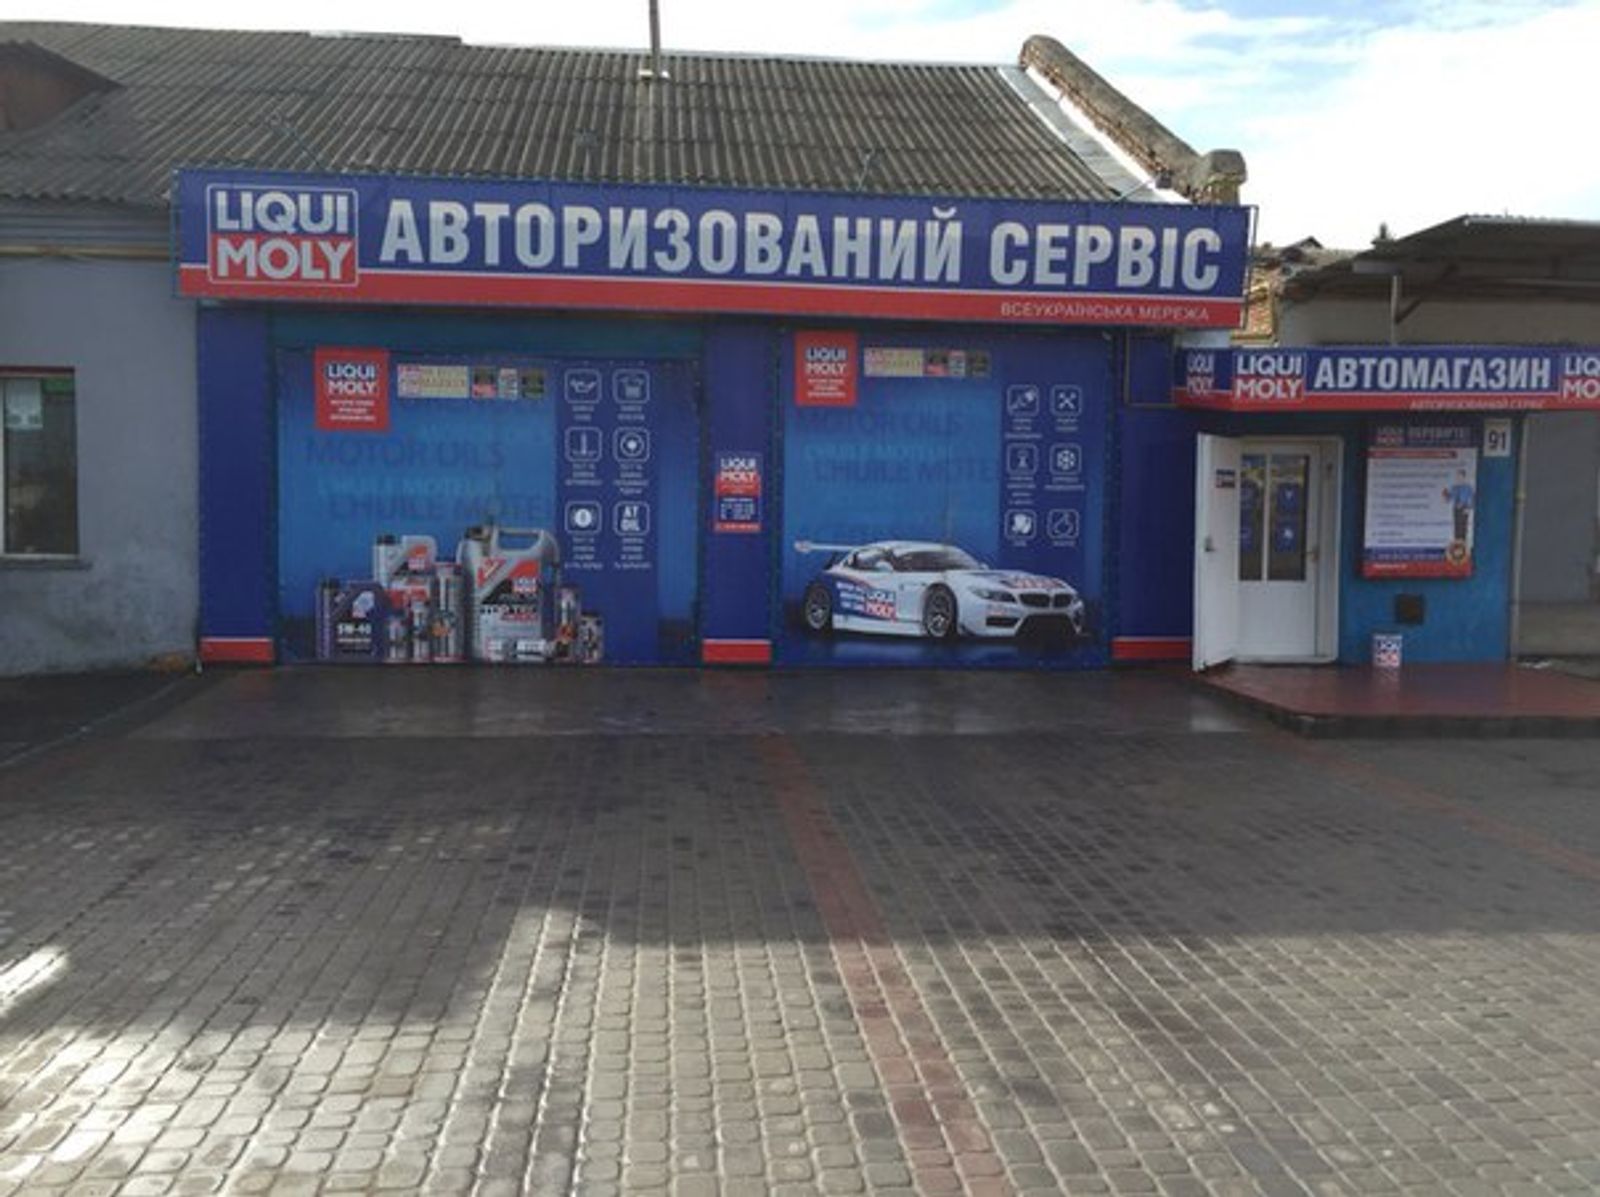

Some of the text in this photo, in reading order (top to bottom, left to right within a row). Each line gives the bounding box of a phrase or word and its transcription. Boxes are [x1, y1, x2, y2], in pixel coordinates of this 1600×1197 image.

[214, 190, 348, 234] LIQUI
[380, 198, 1222, 291] АВТОРИЗОВАНИЙ СЕРВІС
[215, 237, 353, 281] MOLY
[1000, 302, 1210, 321] ВСЕУКРАЇНСЬКА МЕРЕЖА
[806, 347, 847, 362] LIQUI
[1187, 353, 1215, 373] LIQUI
[327, 363, 376, 379] LIQUI
[805, 362, 847, 375] MOLY
[1236, 354, 1302, 377] LIQUI
[1313, 357, 1551, 390] АВТОМАГАЗИН
[327, 381, 377, 395] MOLY
[1187, 375, 1215, 396] MOLY
[1234, 378, 1305, 400] MOLY
[1488, 430, 1507, 449] 91
